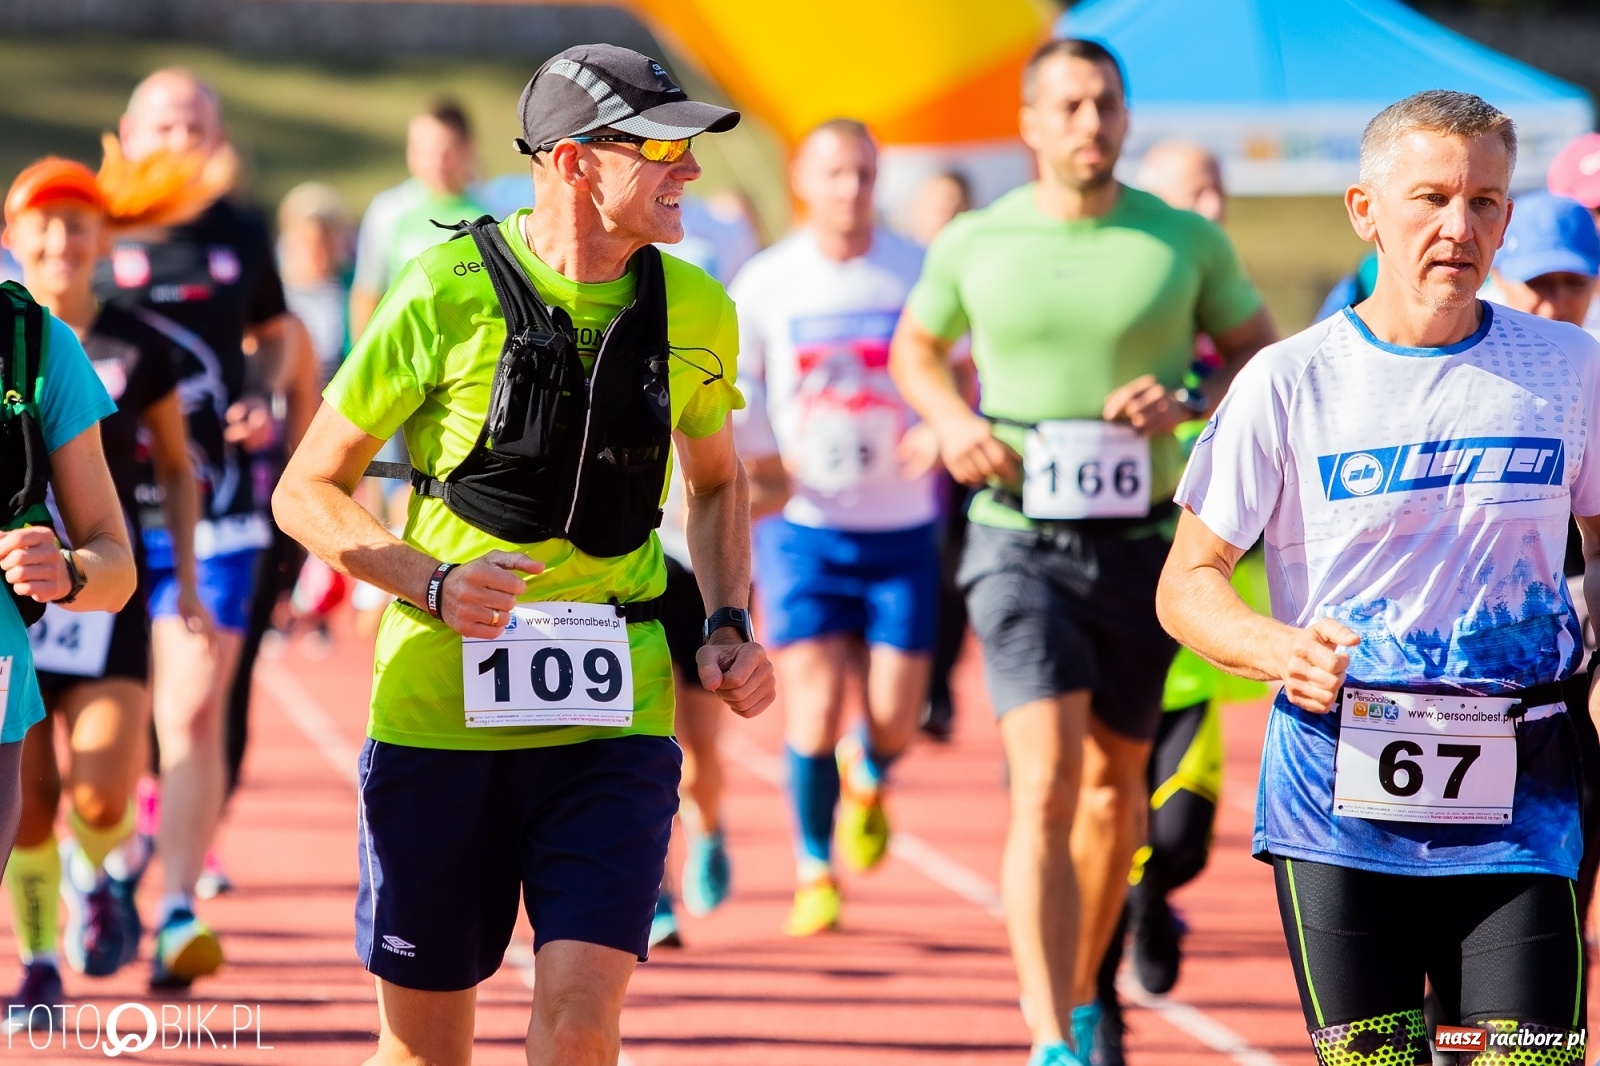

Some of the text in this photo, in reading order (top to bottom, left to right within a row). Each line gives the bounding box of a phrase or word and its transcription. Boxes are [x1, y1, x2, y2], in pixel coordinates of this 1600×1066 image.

[1041, 459, 1140, 498] 166
[1400, 444, 1554, 483] berger
[526, 616, 621, 629] www.personalbest.pl
[478, 646, 623, 703] 109
[1378, 740, 1482, 799] 67
[381, 942, 416, 957] UMBRO
